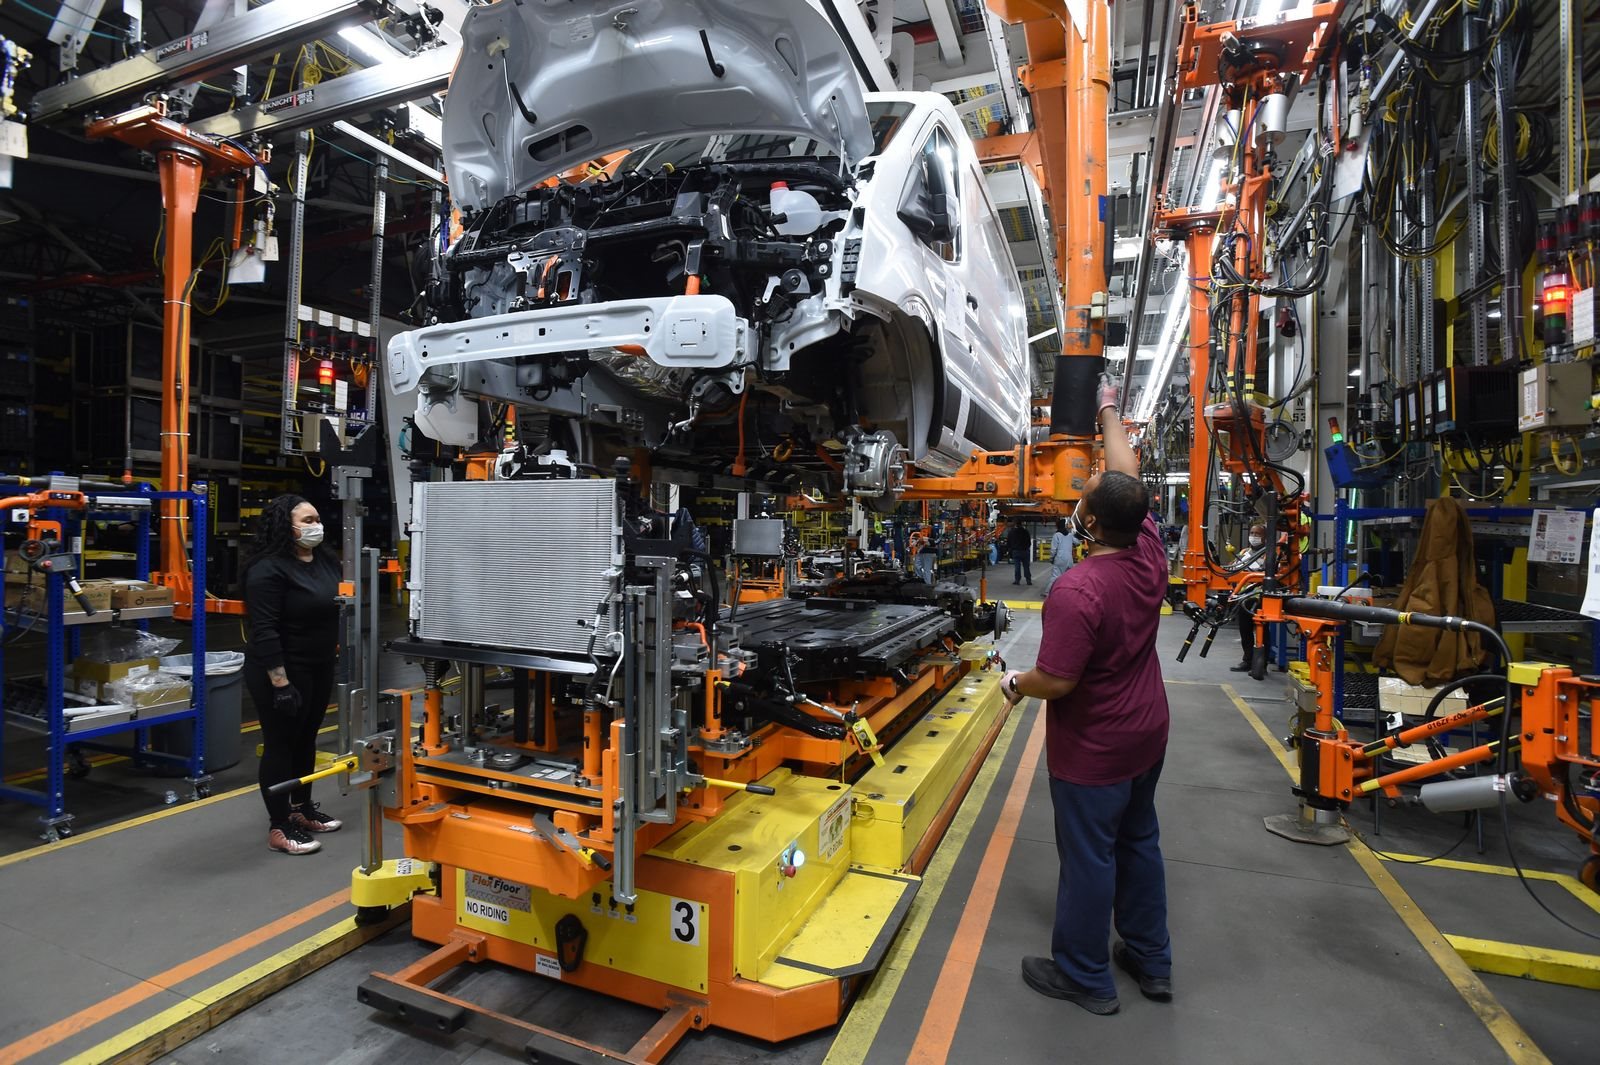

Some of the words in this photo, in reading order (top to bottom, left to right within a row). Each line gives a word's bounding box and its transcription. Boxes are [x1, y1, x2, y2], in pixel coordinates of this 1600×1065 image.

[160, 39, 187, 54] KNIGHT
[267, 96, 292, 109] KNIGHT
[1297, 397, 1304, 406] N
[472, 874, 493, 887] Flex
[493, 879, 521, 895] Floor
[466, 900, 479, 914] NO
[480, 904, 508, 922] RIDING
[674, 901, 696, 943] 3
